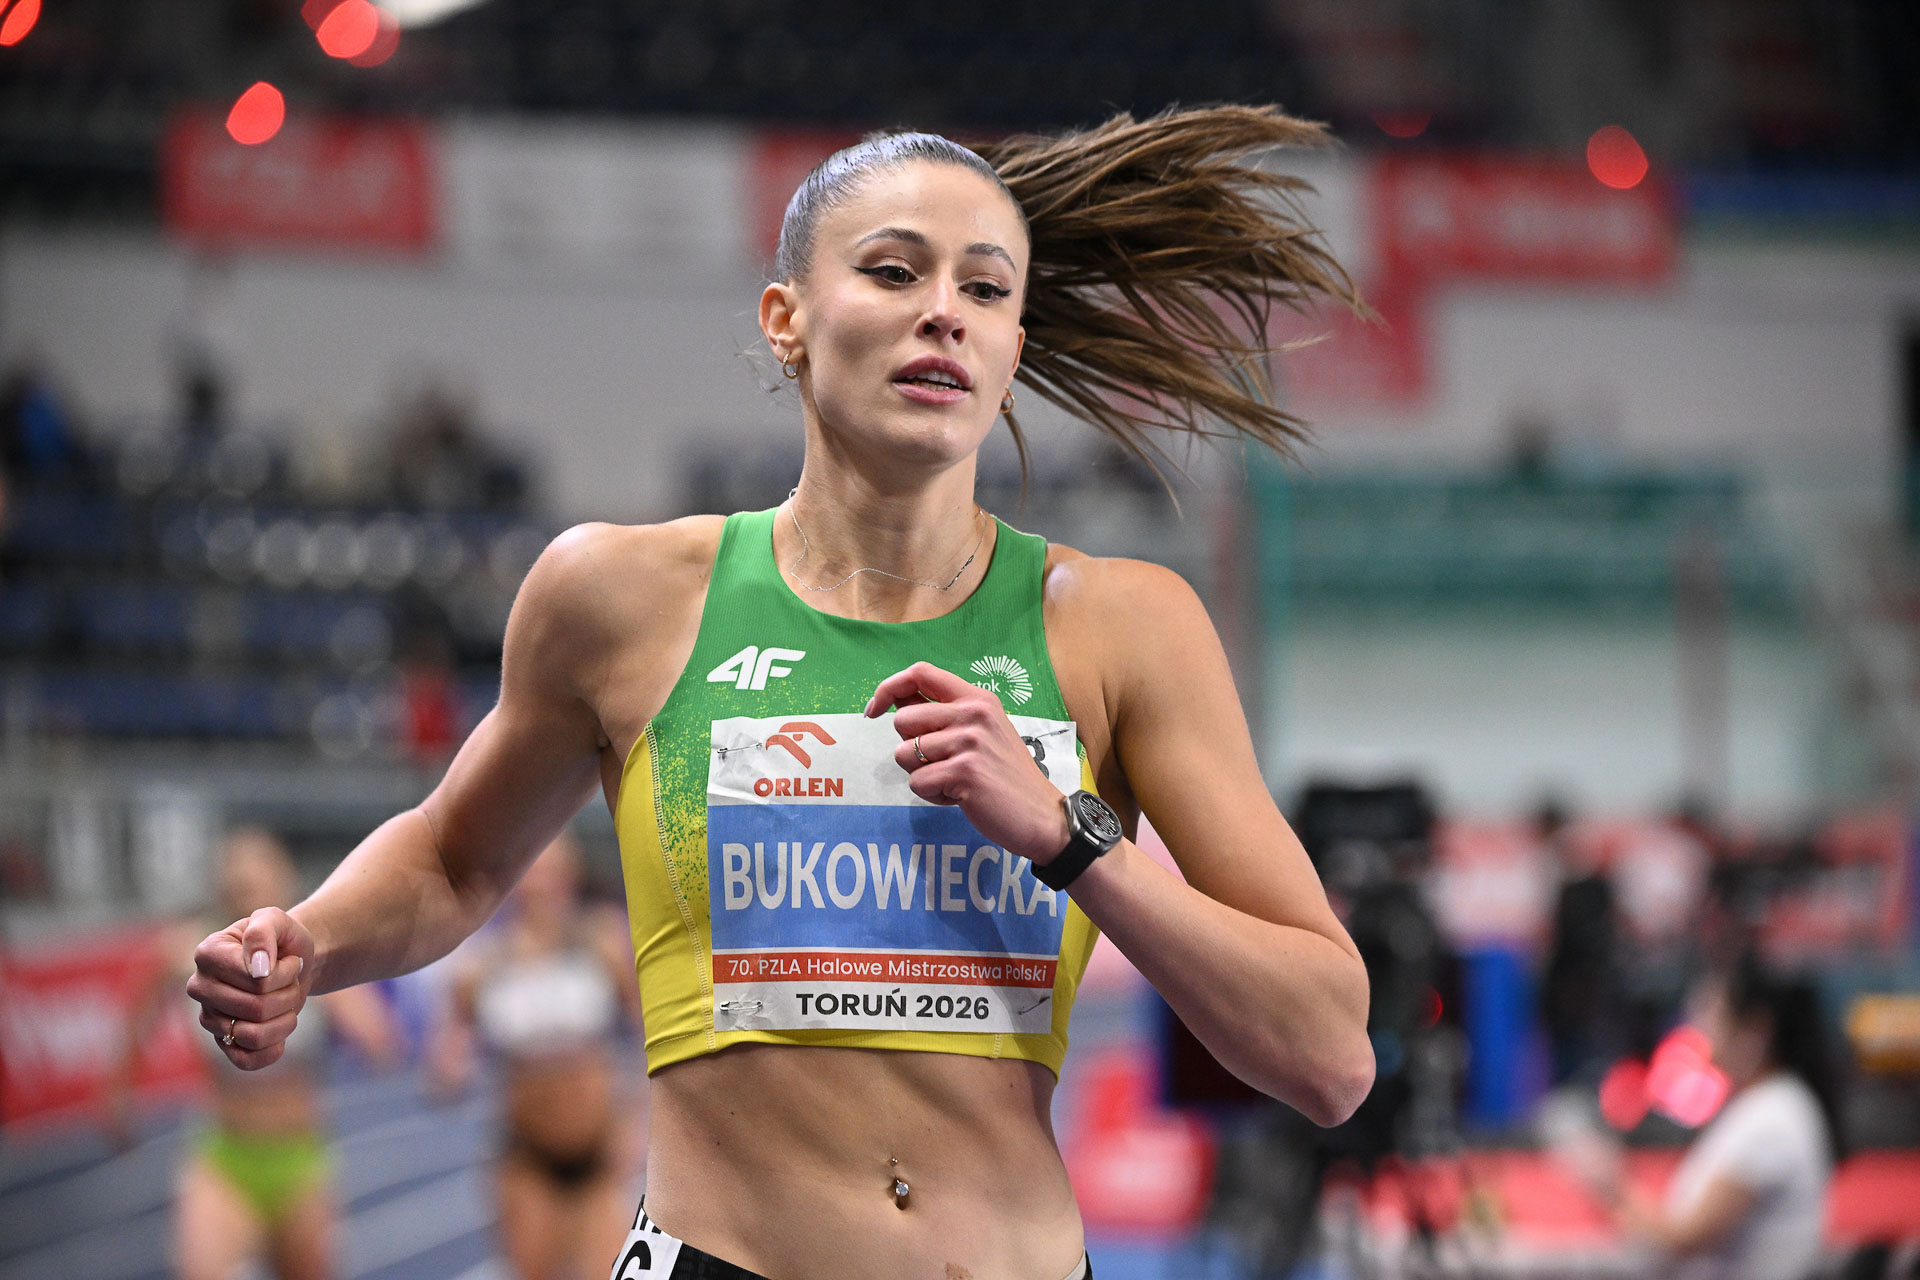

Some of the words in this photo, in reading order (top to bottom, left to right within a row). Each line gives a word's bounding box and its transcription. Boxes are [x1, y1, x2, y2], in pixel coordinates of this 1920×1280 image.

[706, 645, 806, 690] 4F
[970, 679, 1001, 692] tok
[753, 777, 844, 798] ORLEN
[722, 841, 1058, 918] BUKOWIECKA
[728, 959, 753, 977] 70.
[759, 959, 801, 975] PZLA
[807, 958, 883, 976] Halowe
[888, 960, 1002, 980] Mistrzostwa
[1005, 964, 1048, 982] Polski
[796, 987, 907, 1017] TORUŃ
[915, 994, 990, 1020] 2026
